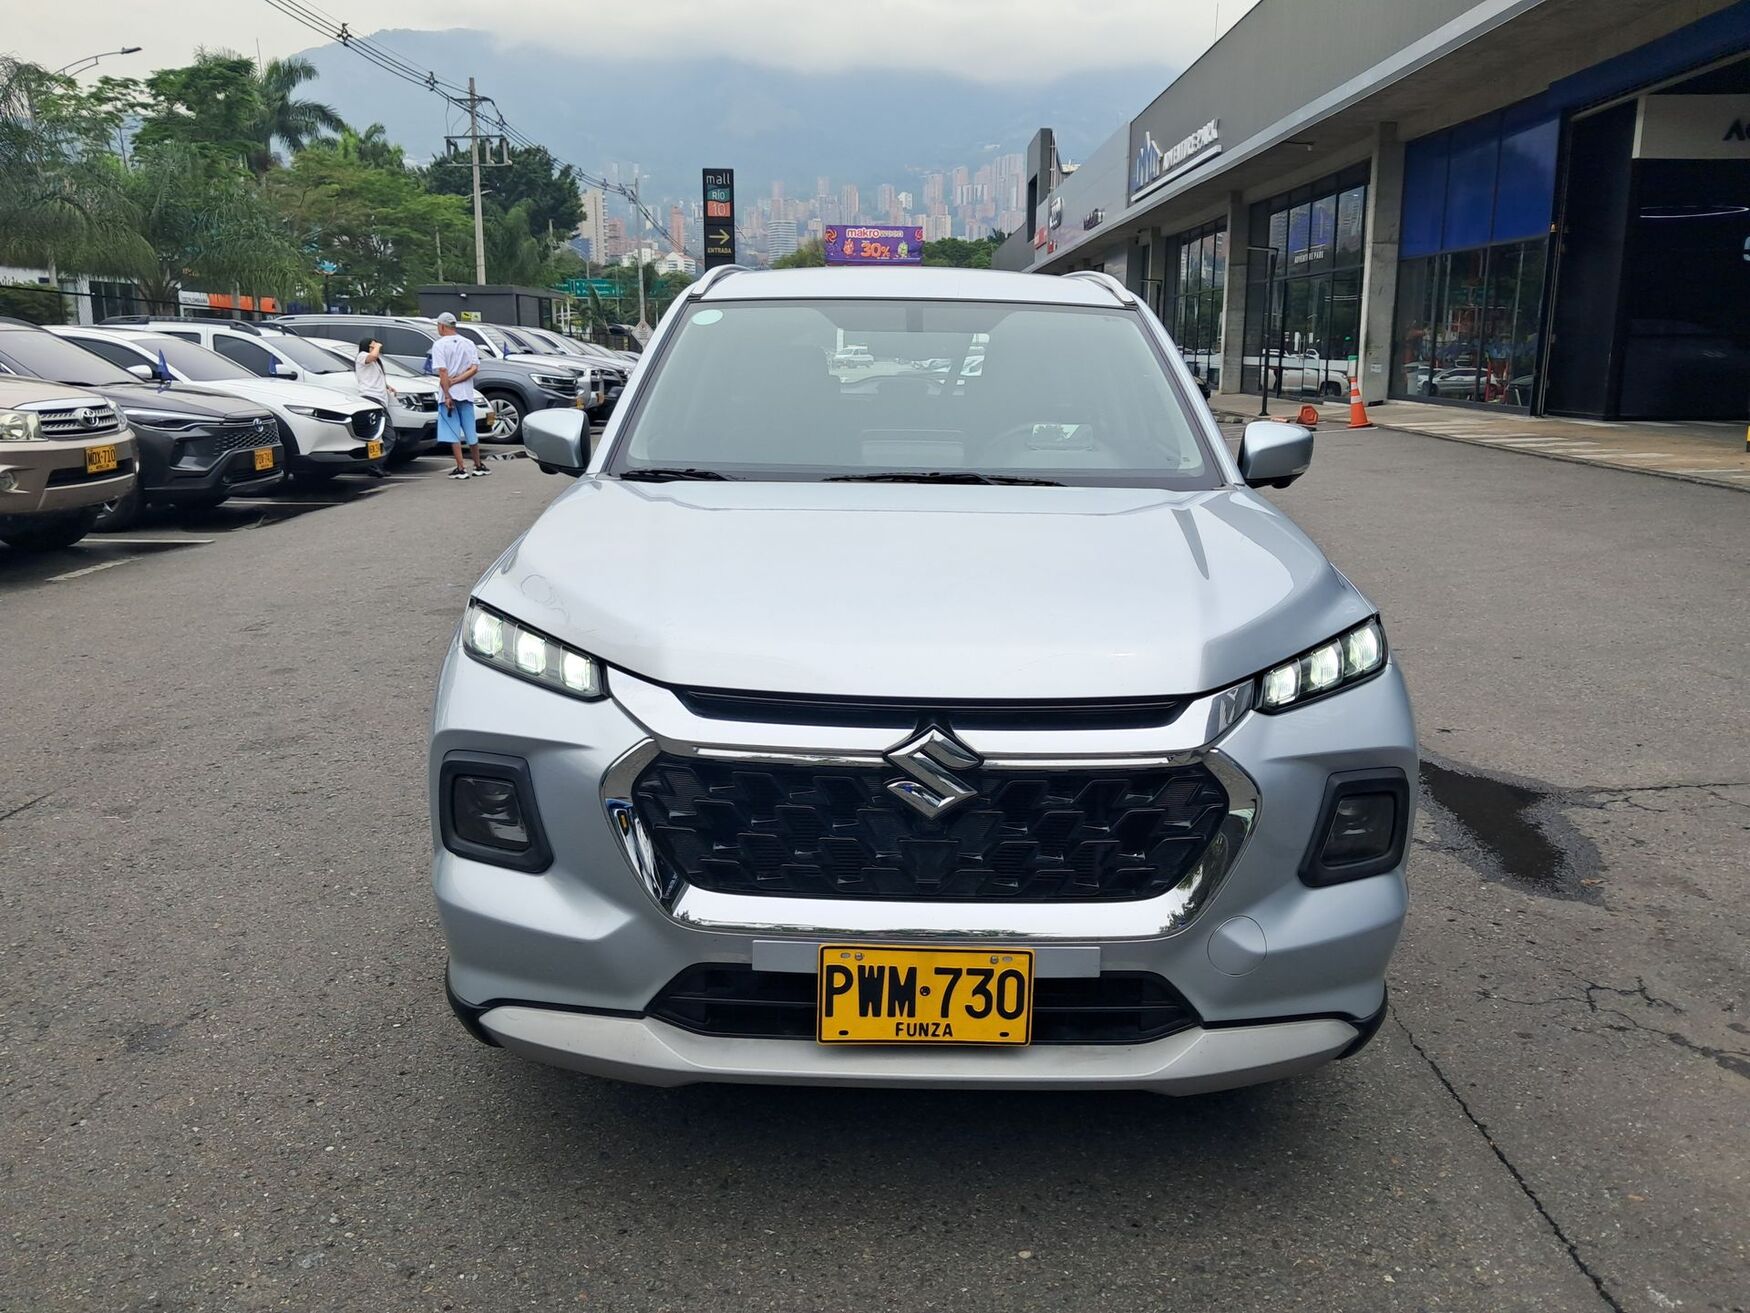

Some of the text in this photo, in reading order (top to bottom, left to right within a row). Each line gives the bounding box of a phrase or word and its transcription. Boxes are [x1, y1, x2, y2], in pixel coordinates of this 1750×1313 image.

[706, 172, 731, 185] mall
[713, 203, 726, 216] 10
[861, 242, 890, 257] 30%
[895, 1021, 954, 1039] FUNZA
